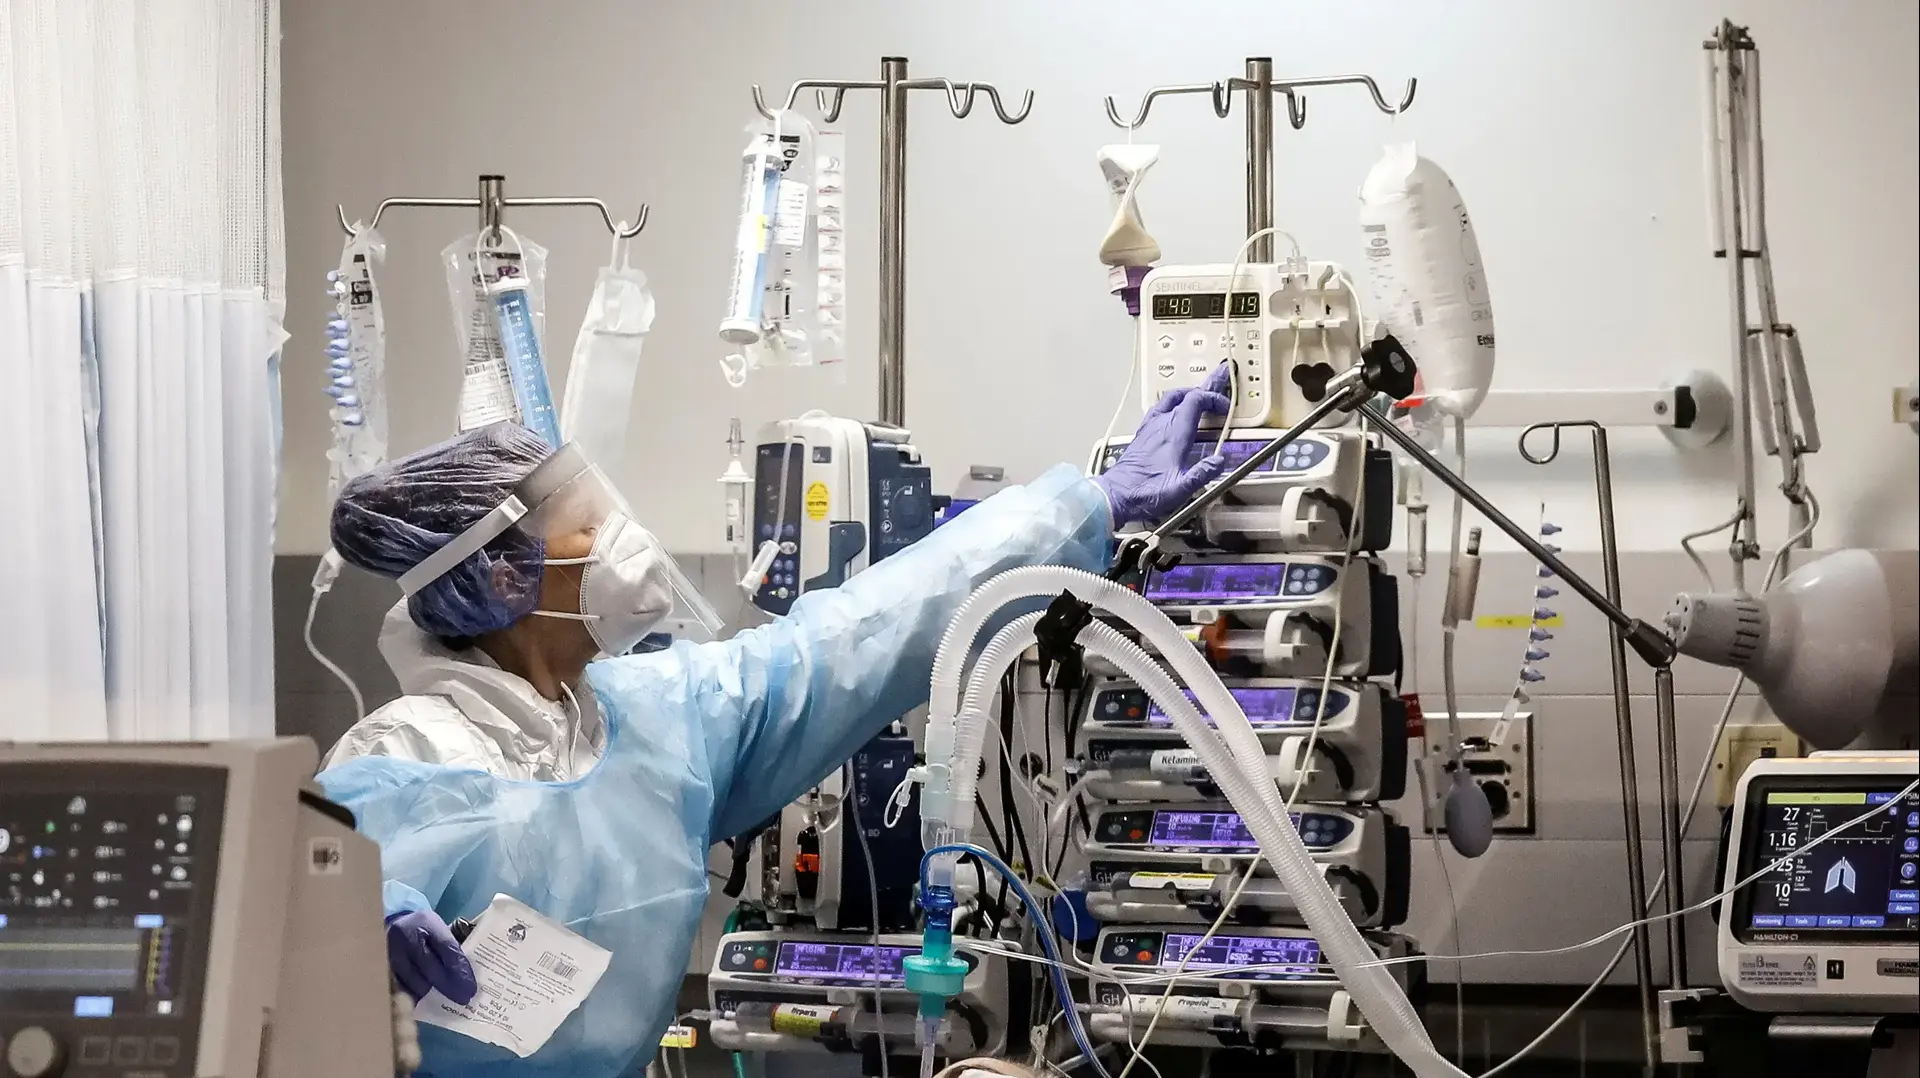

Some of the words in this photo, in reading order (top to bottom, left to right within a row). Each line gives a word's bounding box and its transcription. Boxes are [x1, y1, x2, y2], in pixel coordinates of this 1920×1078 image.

[1169, 298, 1191, 314] 40
[1783, 807, 1800, 821] 27
[1769, 832, 1797, 846] 1.16
[1775, 883, 1791, 897] 10
[1239, 938, 1273, 948] PROPOFOL
[488, 999, 502, 1010] Pcs
[1102, 993, 1119, 1005] GH
[1178, 999, 1209, 1007] Propofol
[791, 1007, 817, 1017] Heparin
